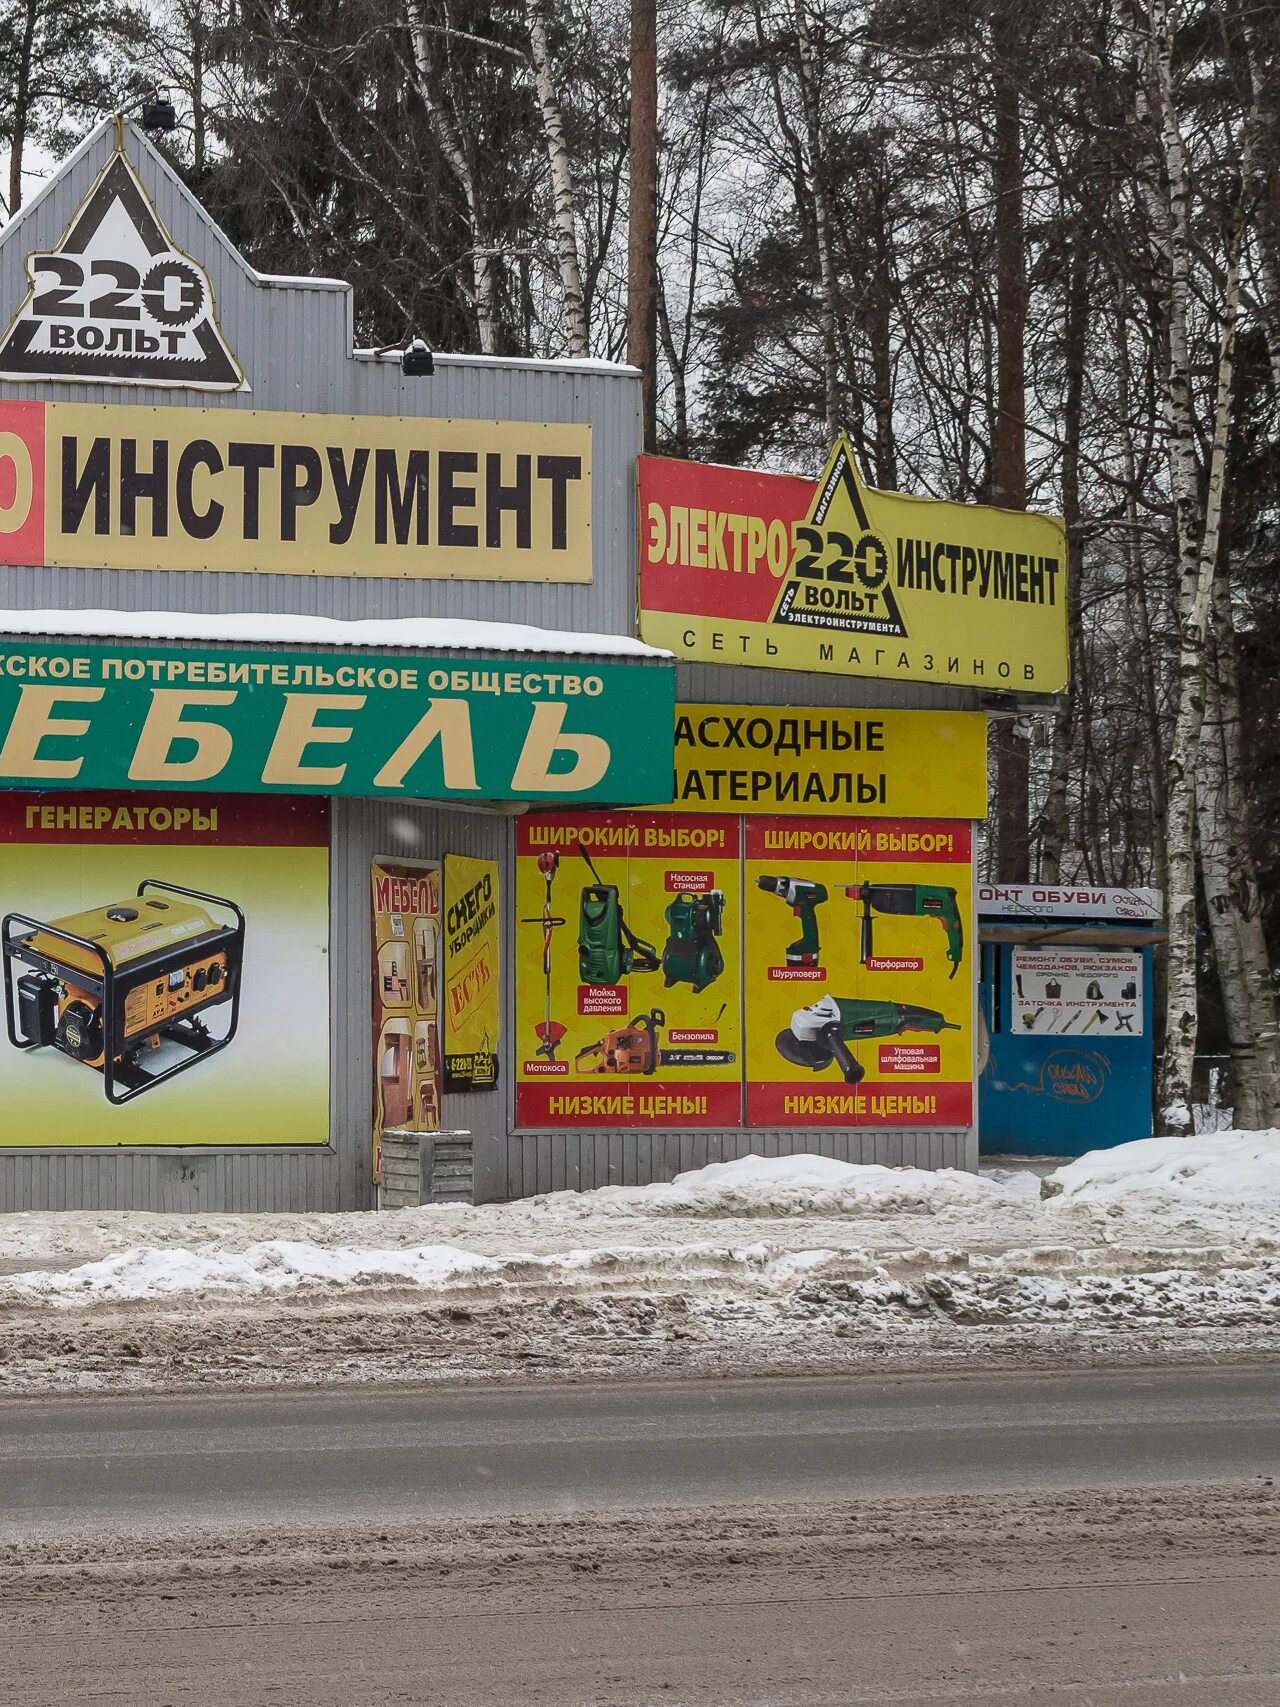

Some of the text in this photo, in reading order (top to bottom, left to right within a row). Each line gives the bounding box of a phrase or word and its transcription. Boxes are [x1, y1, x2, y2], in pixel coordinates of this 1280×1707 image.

[32, 256, 206, 327] 220
[49, 324, 187, 357] ВОЛЬТ
[61, 436, 581, 550] ИНСТРУМЕНТ
[816, 454, 846, 524] МАГАЗИНОВ
[648, 503, 1058, 606] ЭЛЕКТРО 220 ИНСТРУМЕНТ
[780, 588, 795, 617] СЕТЬ
[805, 585, 878, 613] ВОЛЬТ
[788, 613, 901, 633] ЭЛЕКТРОИНСТРУМЕНТА
[682, 630, 1035, 680] СЕТЬ МАГАЗИНОВ
[101, 658, 418, 690] ПОТРЕБИТЕЛЬСКОЕ
[428, 669, 604, 697] ОБЩЕСТВО
[674, 716, 885, 756] АСХОДНЫЕ
[25, 805, 219, 831] ГЕНЕРАТОРЫ
[529, 825, 726, 848] ШИРОКИЙ ВЫБОР!
[764, 829, 954, 853] ШИРОКИЙ ВЫБОР!
[671, 874, 708, 883] Насосная
[673, 883, 705, 891] станция
[375, 876, 440, 915] МЕБЕЛЬ
[447, 873, 492, 936] СНЕГО
[978, 889, 1106, 904] ОНТ ОБУВИ
[449, 902, 496, 959] УБОРЩИКИ
[870, 960, 919, 970] Перфоратор
[1016, 964, 1080, 972] ЧЕМОДАНОВ,
[1060, 956, 1096, 965] ОБУВИ,
[772, 969, 821, 980] Шуруповерт
[450, 958, 490, 1015] ЕСТЬ
[589, 987, 616, 997] Мойка
[583, 1005, 622, 1014] давления
[584, 998, 621, 1006] высокого
[672, 1031, 714, 1041] Бензопила
[881, 1056, 938, 1065] шлифовальная
[894, 1047, 924, 1056] Угловая
[526, 1063, 566, 1073] Мотокоса
[549, 1096, 707, 1118] НИЗКИЕ ЦЕНЫ!
[784, 1096, 937, 1117] НИЗКИЕ ЦЕНЫ!
